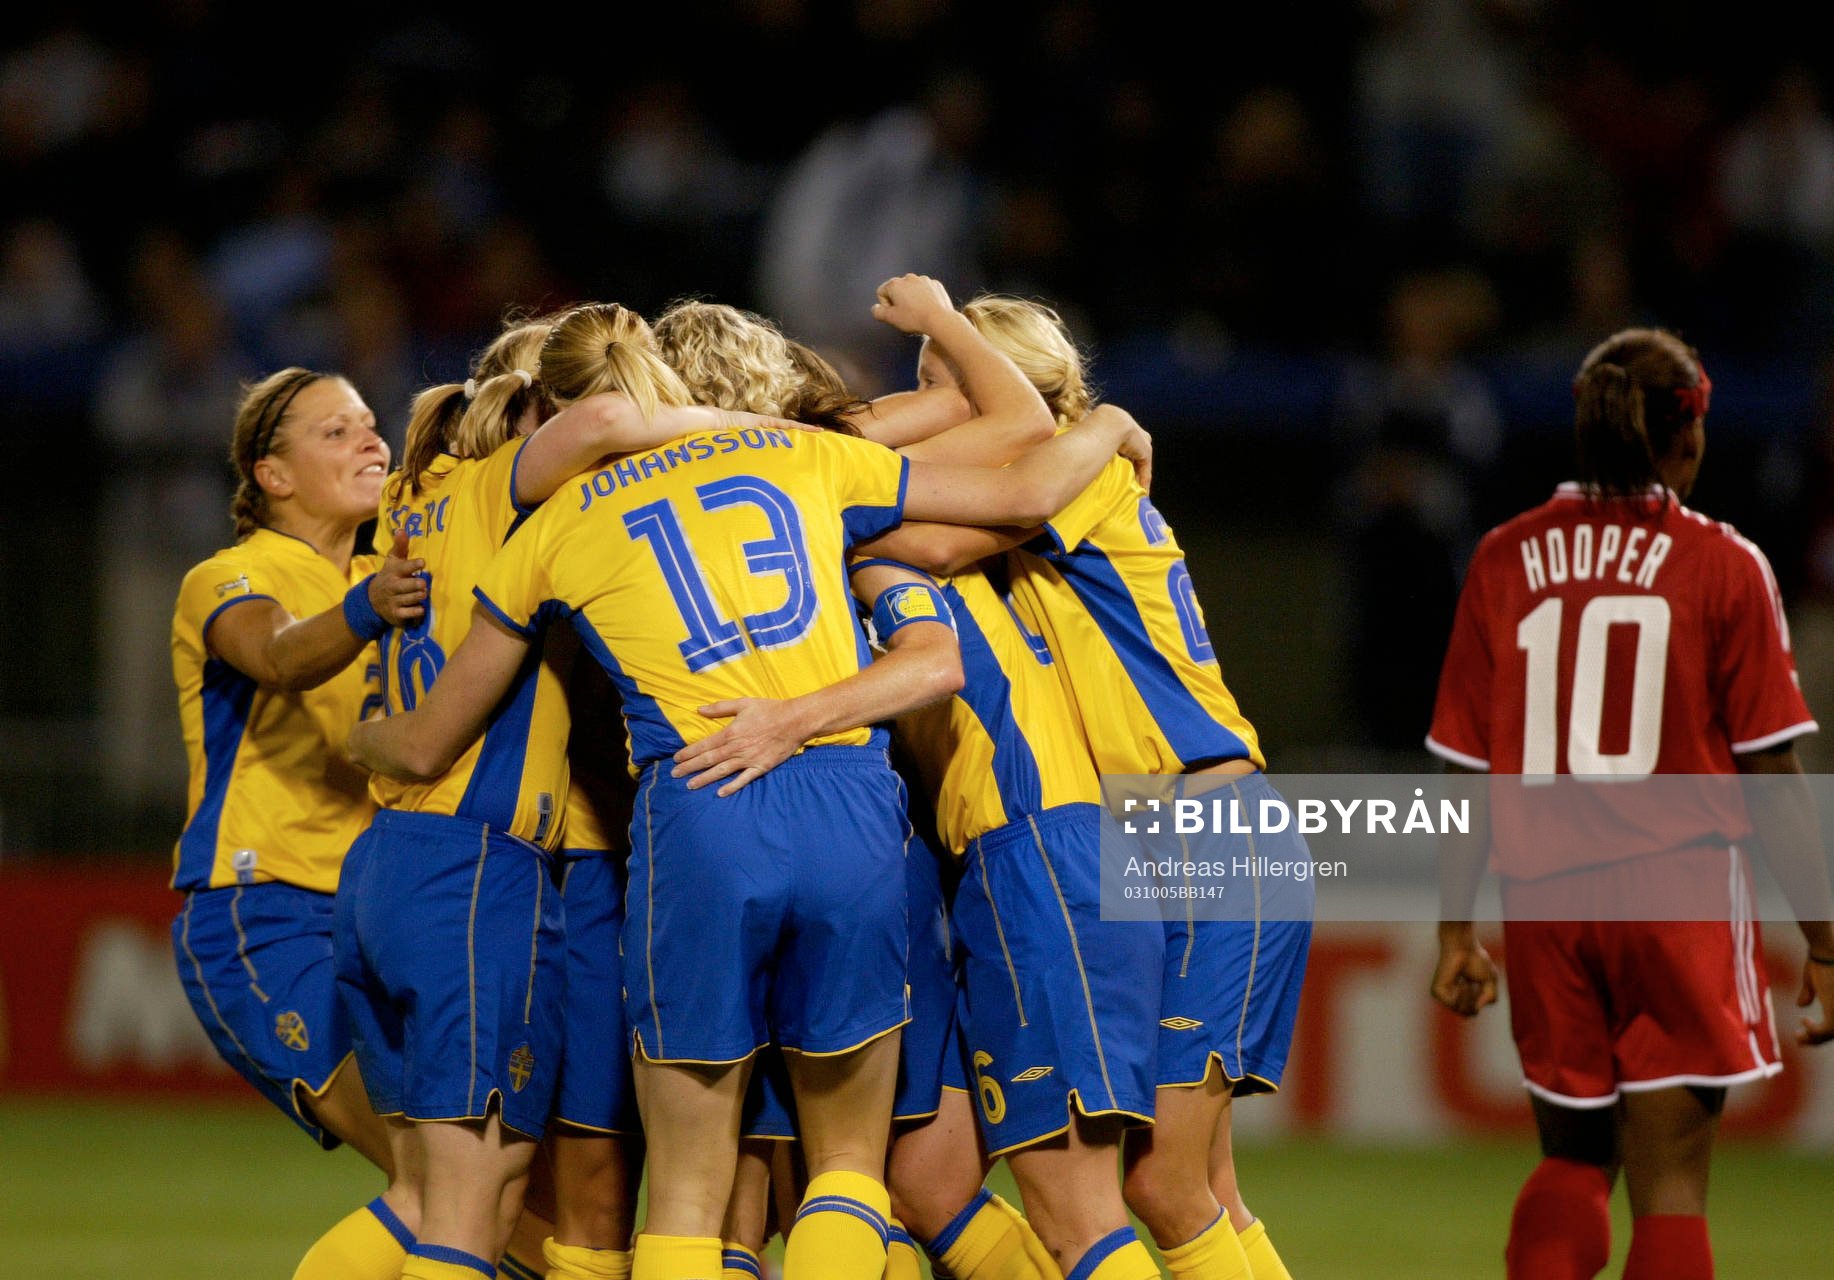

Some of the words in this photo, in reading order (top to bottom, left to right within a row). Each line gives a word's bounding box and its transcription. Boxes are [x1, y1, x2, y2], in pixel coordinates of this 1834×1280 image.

[579, 427, 794, 512] JOHANSSON
[621, 474, 822, 674] 13
[1519, 523, 1673, 593] HOOPER
[1516, 594, 1672, 787] 10
[972, 1049, 1008, 1125] 6
